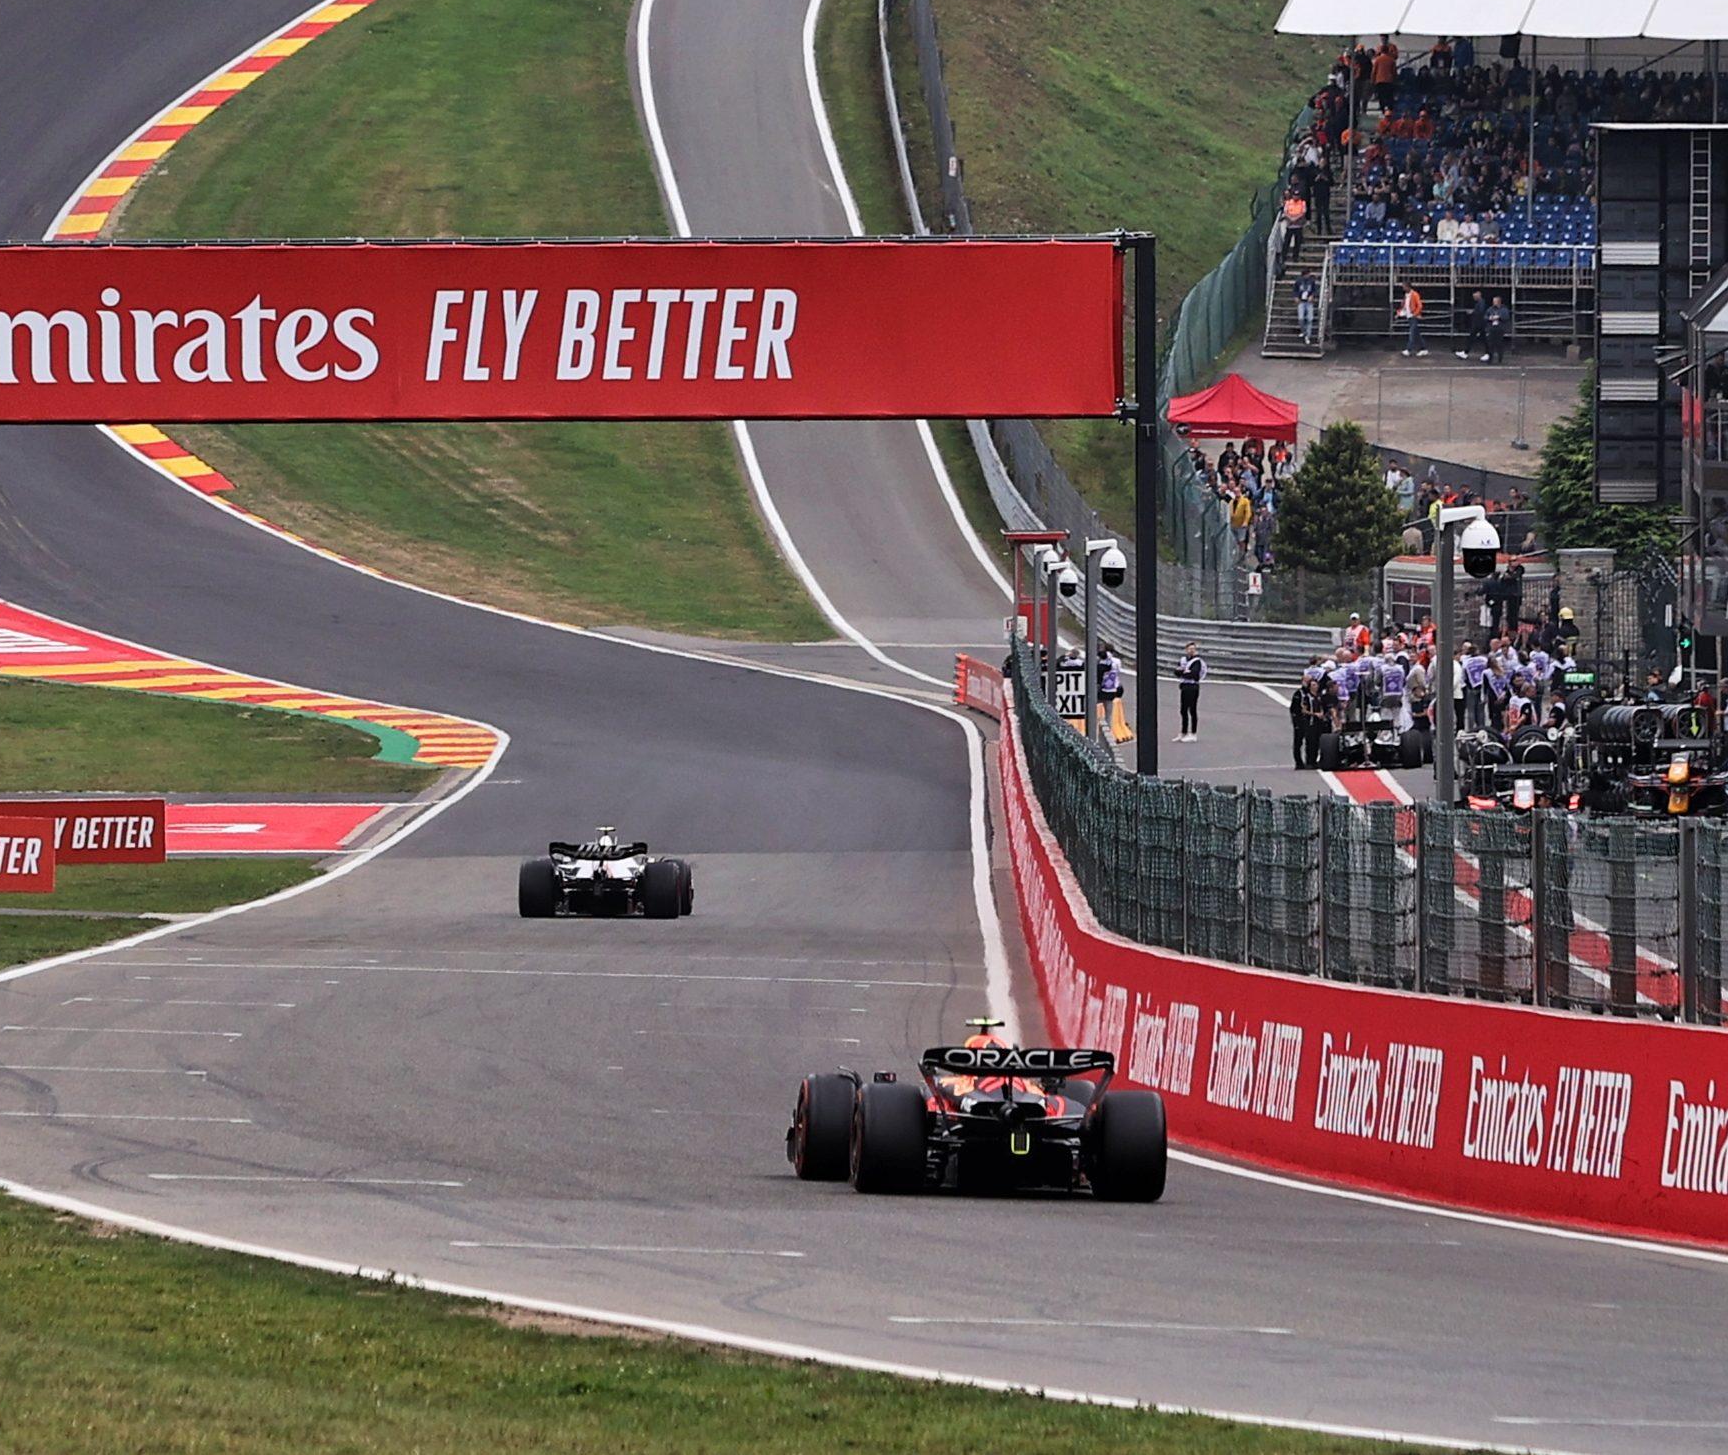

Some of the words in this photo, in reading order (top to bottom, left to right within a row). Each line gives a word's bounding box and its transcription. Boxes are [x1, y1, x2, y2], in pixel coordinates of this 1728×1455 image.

[423, 290, 538, 383] FLY
[555, 289, 799, 383] BETTER
[1055, 673, 1082, 691] PIT
[1057, 695, 1085, 713] XIT
[72, 816, 154, 849] BETTER
[944, 1049, 1093, 1069] ORACLE
[1206, 1010, 1257, 1111] Emirates
[1314, 1032, 1380, 1139] Emirates
[1378, 1043, 1405, 1143] FLY
[1396, 1045, 1443, 1149] BETTER
[1463, 1054, 1547, 1167] Emirates
[1547, 1066, 1581, 1172] FLY
[1572, 1068, 1632, 1179] BETTER
